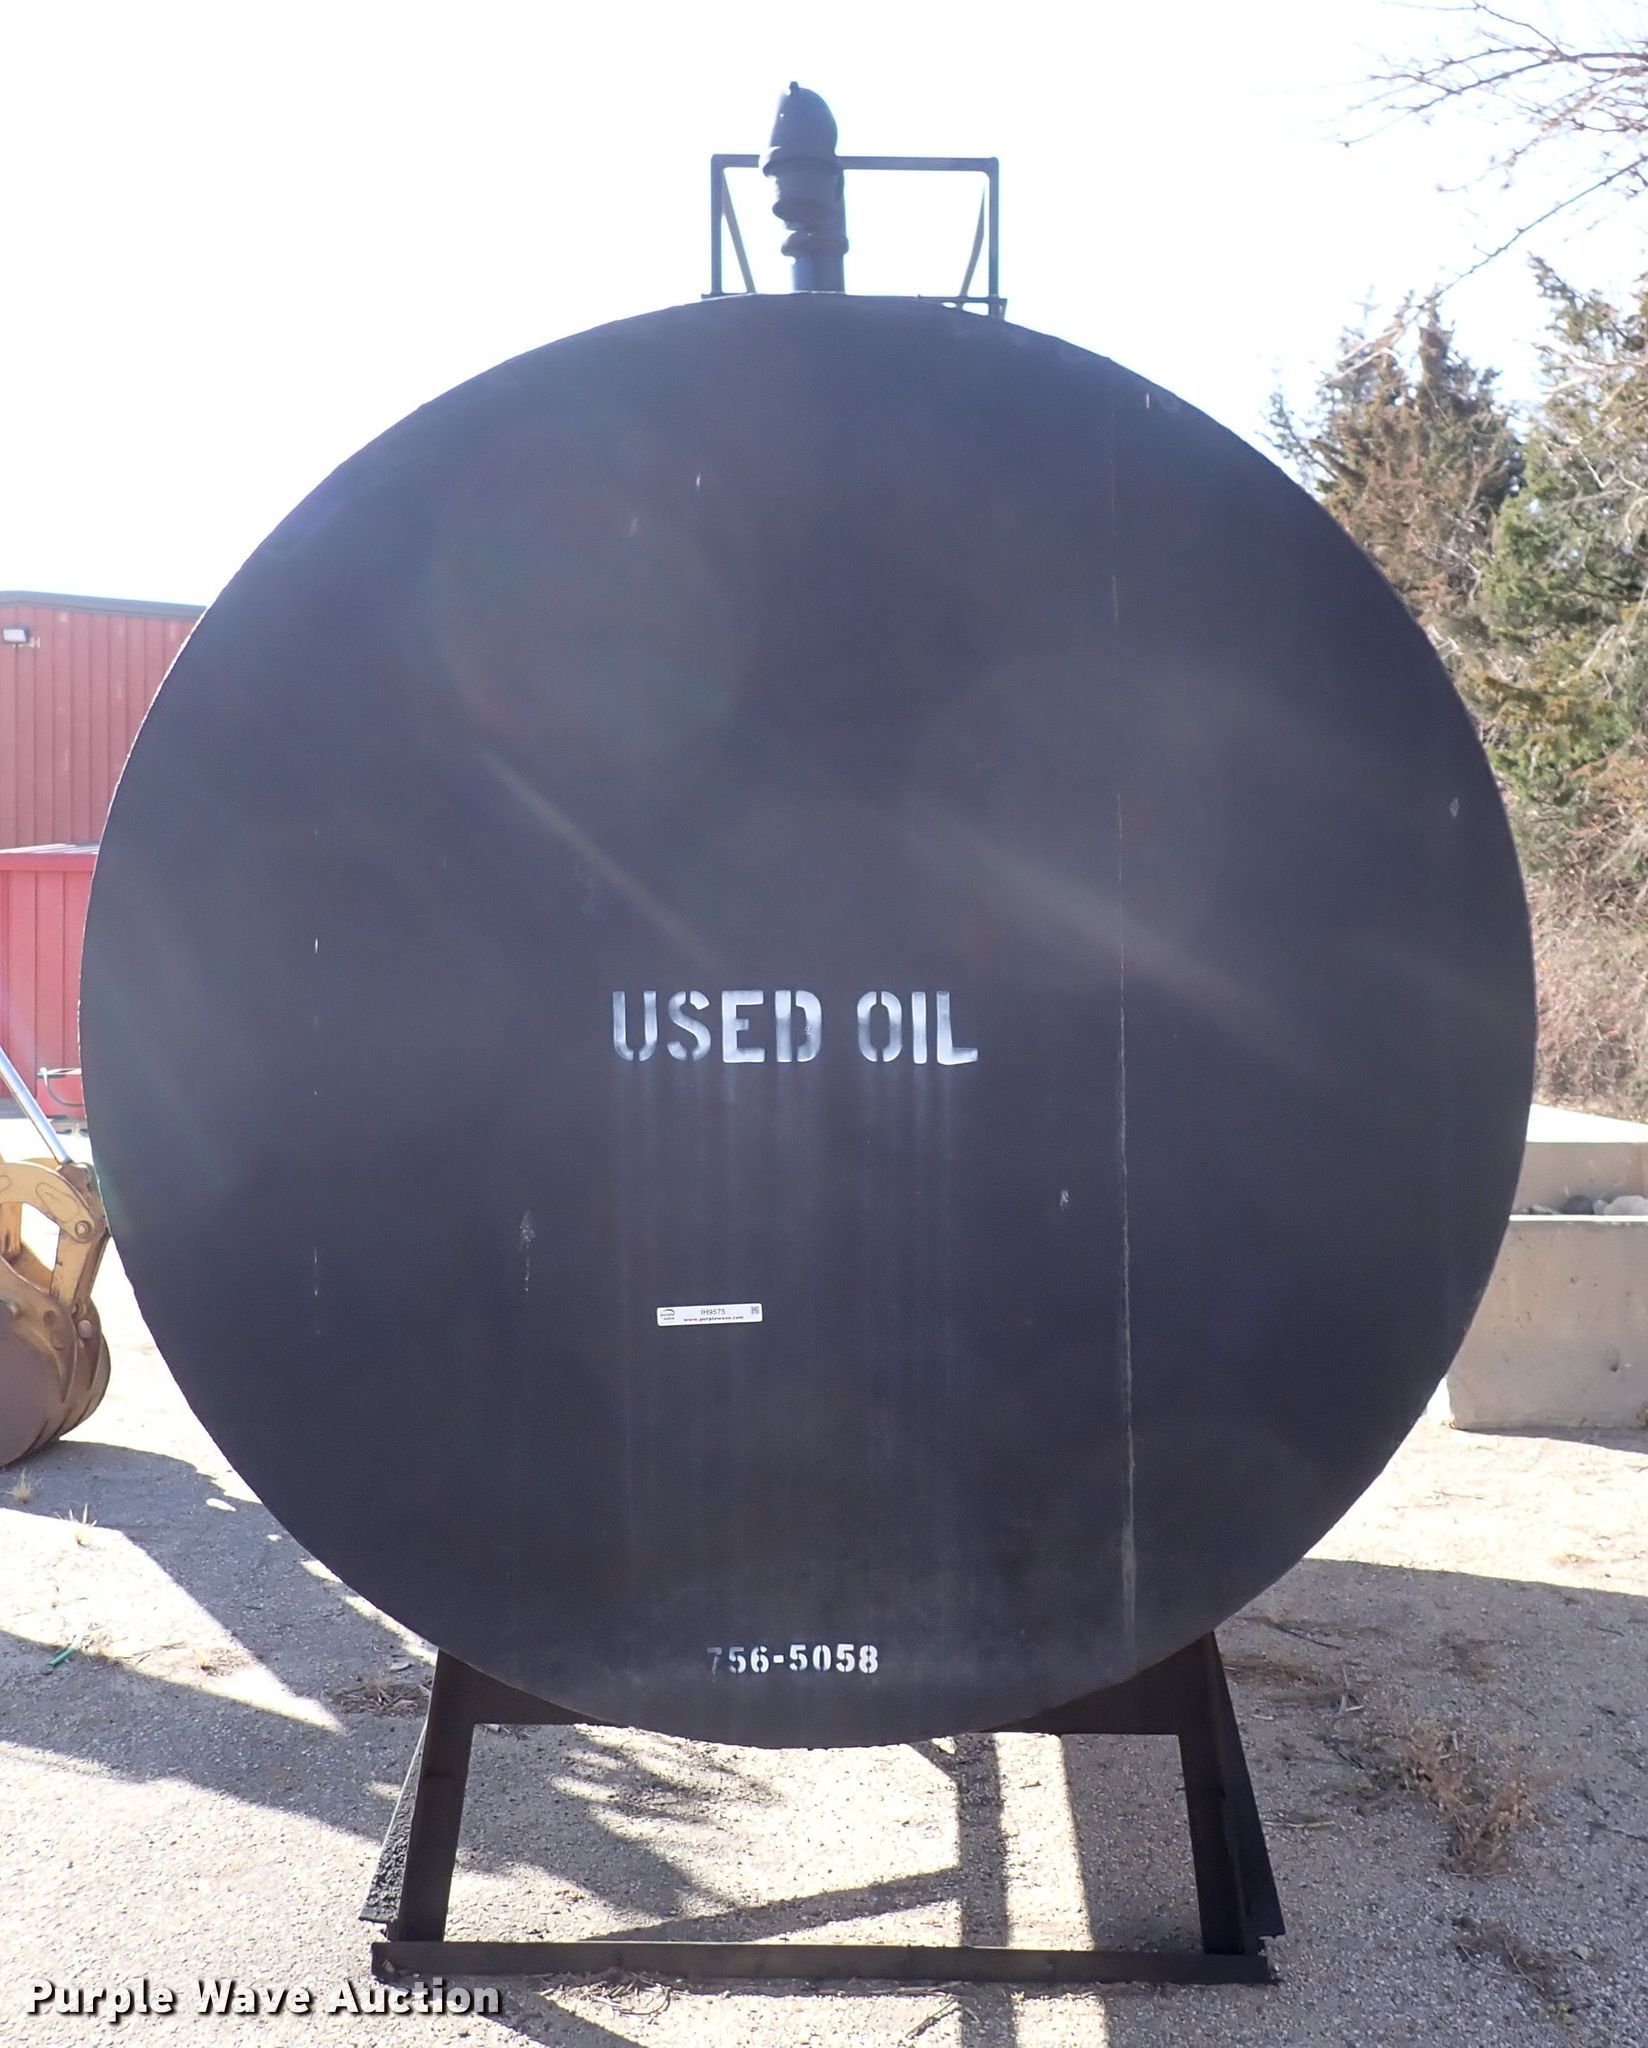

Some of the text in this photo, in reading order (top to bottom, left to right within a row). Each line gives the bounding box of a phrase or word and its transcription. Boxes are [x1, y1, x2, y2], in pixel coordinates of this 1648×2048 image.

[612, 990, 979, 1065] USED OIL
[707, 1643, 879, 1675] 756-5058
